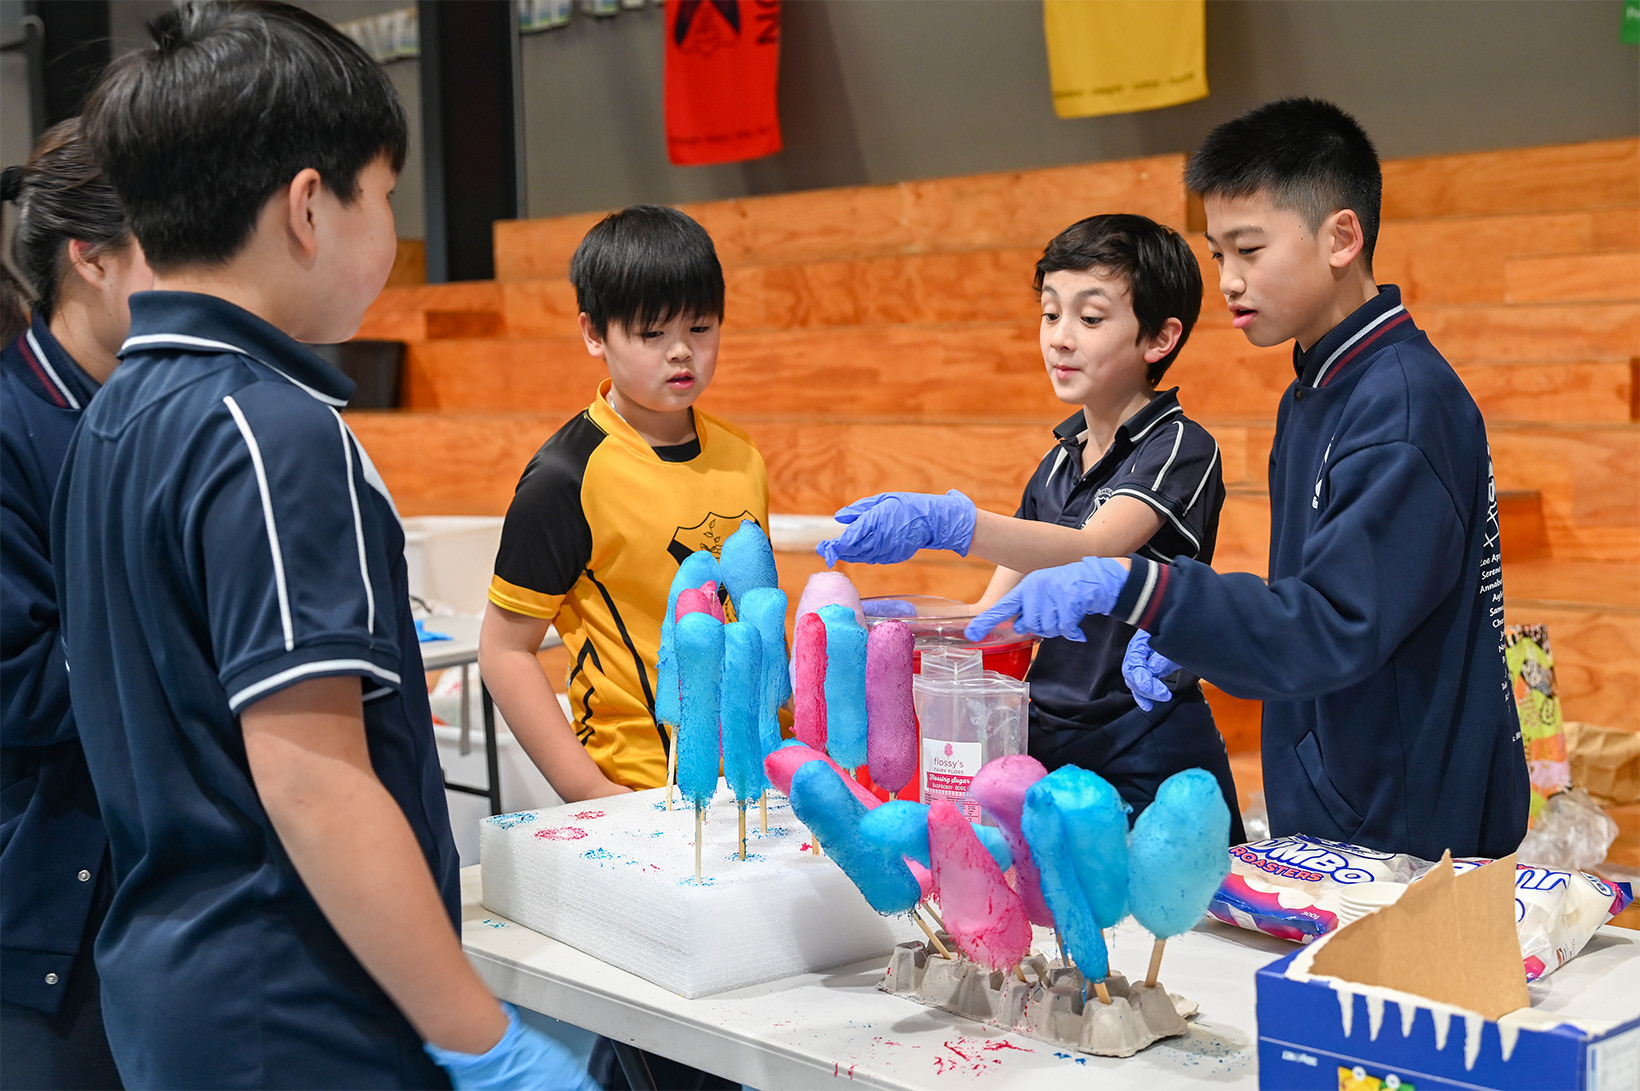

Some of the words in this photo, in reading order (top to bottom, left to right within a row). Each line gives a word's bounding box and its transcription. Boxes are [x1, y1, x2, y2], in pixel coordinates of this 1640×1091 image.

[934, 757, 964, 769] flossy's
[1229, 846, 1324, 882] ROASTERS
[1246, 839, 1375, 885] UMBO
[1300, 911, 1320, 920] 300g
